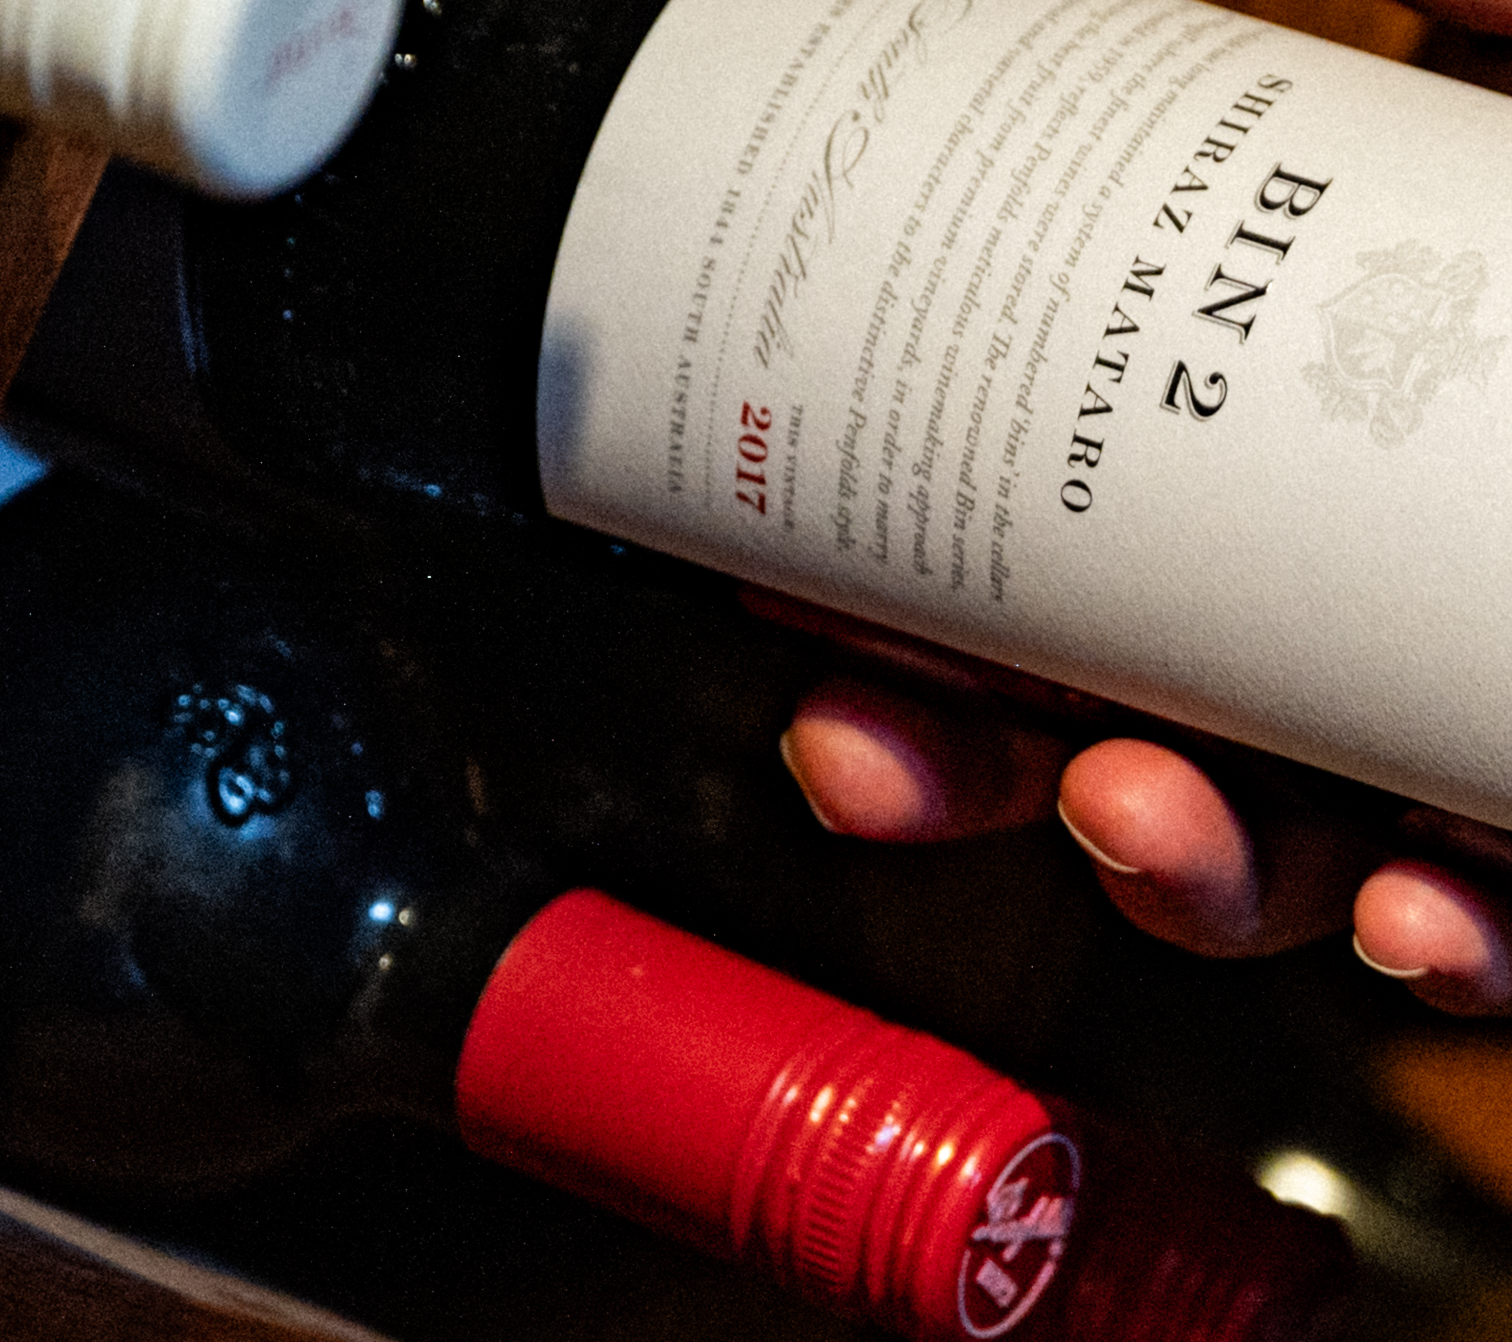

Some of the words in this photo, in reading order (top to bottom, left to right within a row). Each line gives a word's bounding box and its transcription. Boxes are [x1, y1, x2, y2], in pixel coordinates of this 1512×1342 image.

[735, 22, 832, 177] ESTABLISHED
[967, 47, 1022, 117] varietal
[1018, 61, 1063, 108] fruit
[1122, 72, 1148, 97] the
[1168, 62, 1211, 91] long
[988, 106, 1028, 153] from
[1041, 85, 1087, 141] reflects
[1088, 89, 1133, 142] finest
[1106, 89, 1179, 187] maintained
[913, 113, 975, 213] characters
[996, 141, 1053, 224] Penfolds
[1053, 143, 1095, 199] wines
[1151, 78, 1289, 235] SHIRAZ
[708, 187, 743, 247] 1844
[939, 148, 996, 252] premium
[1097, 184, 1112, 200] a
[753, 109, 884, 371] Australia
[887, 239, 913, 279] the
[902, 214, 923, 238] to
[1026, 201, 1061, 253] were
[1063, 201, 1104, 269] system
[1197, 164, 1332, 340] BIN
[681, 257, 717, 345] SOUTH
[896, 254, 949, 373] vineyards,
[950, 226, 1004, 339] meticulous
[999, 254, 1035, 327] stored.
[1049, 271, 1072, 303] of
[850, 279, 900, 404] distinctive
[984, 332, 1012, 372] The
[1014, 297, 1061, 414] numbered
[891, 378, 909, 405] in
[911, 344, 961, 483] winemaking
[1060, 255, 1166, 515] MATARO
[1163, 359, 1228, 419] 2
[667, 358, 692, 494] AUSTRALIA
[735, 400, 772, 516] 2017
[787, 404, 805, 449] THIS
[837, 405, 869, 501] Penfolds
[881, 408, 902, 472] order
[958, 374, 993, 492] renowned
[877, 472, 895, 496] to
[952, 489, 976, 532] Bin
[996, 474, 1013, 501] in
[873, 499, 890, 565] marry
[907, 483, 934, 577] approach
[991, 502, 1013, 540] the
[989, 539, 1010, 604] cellars
